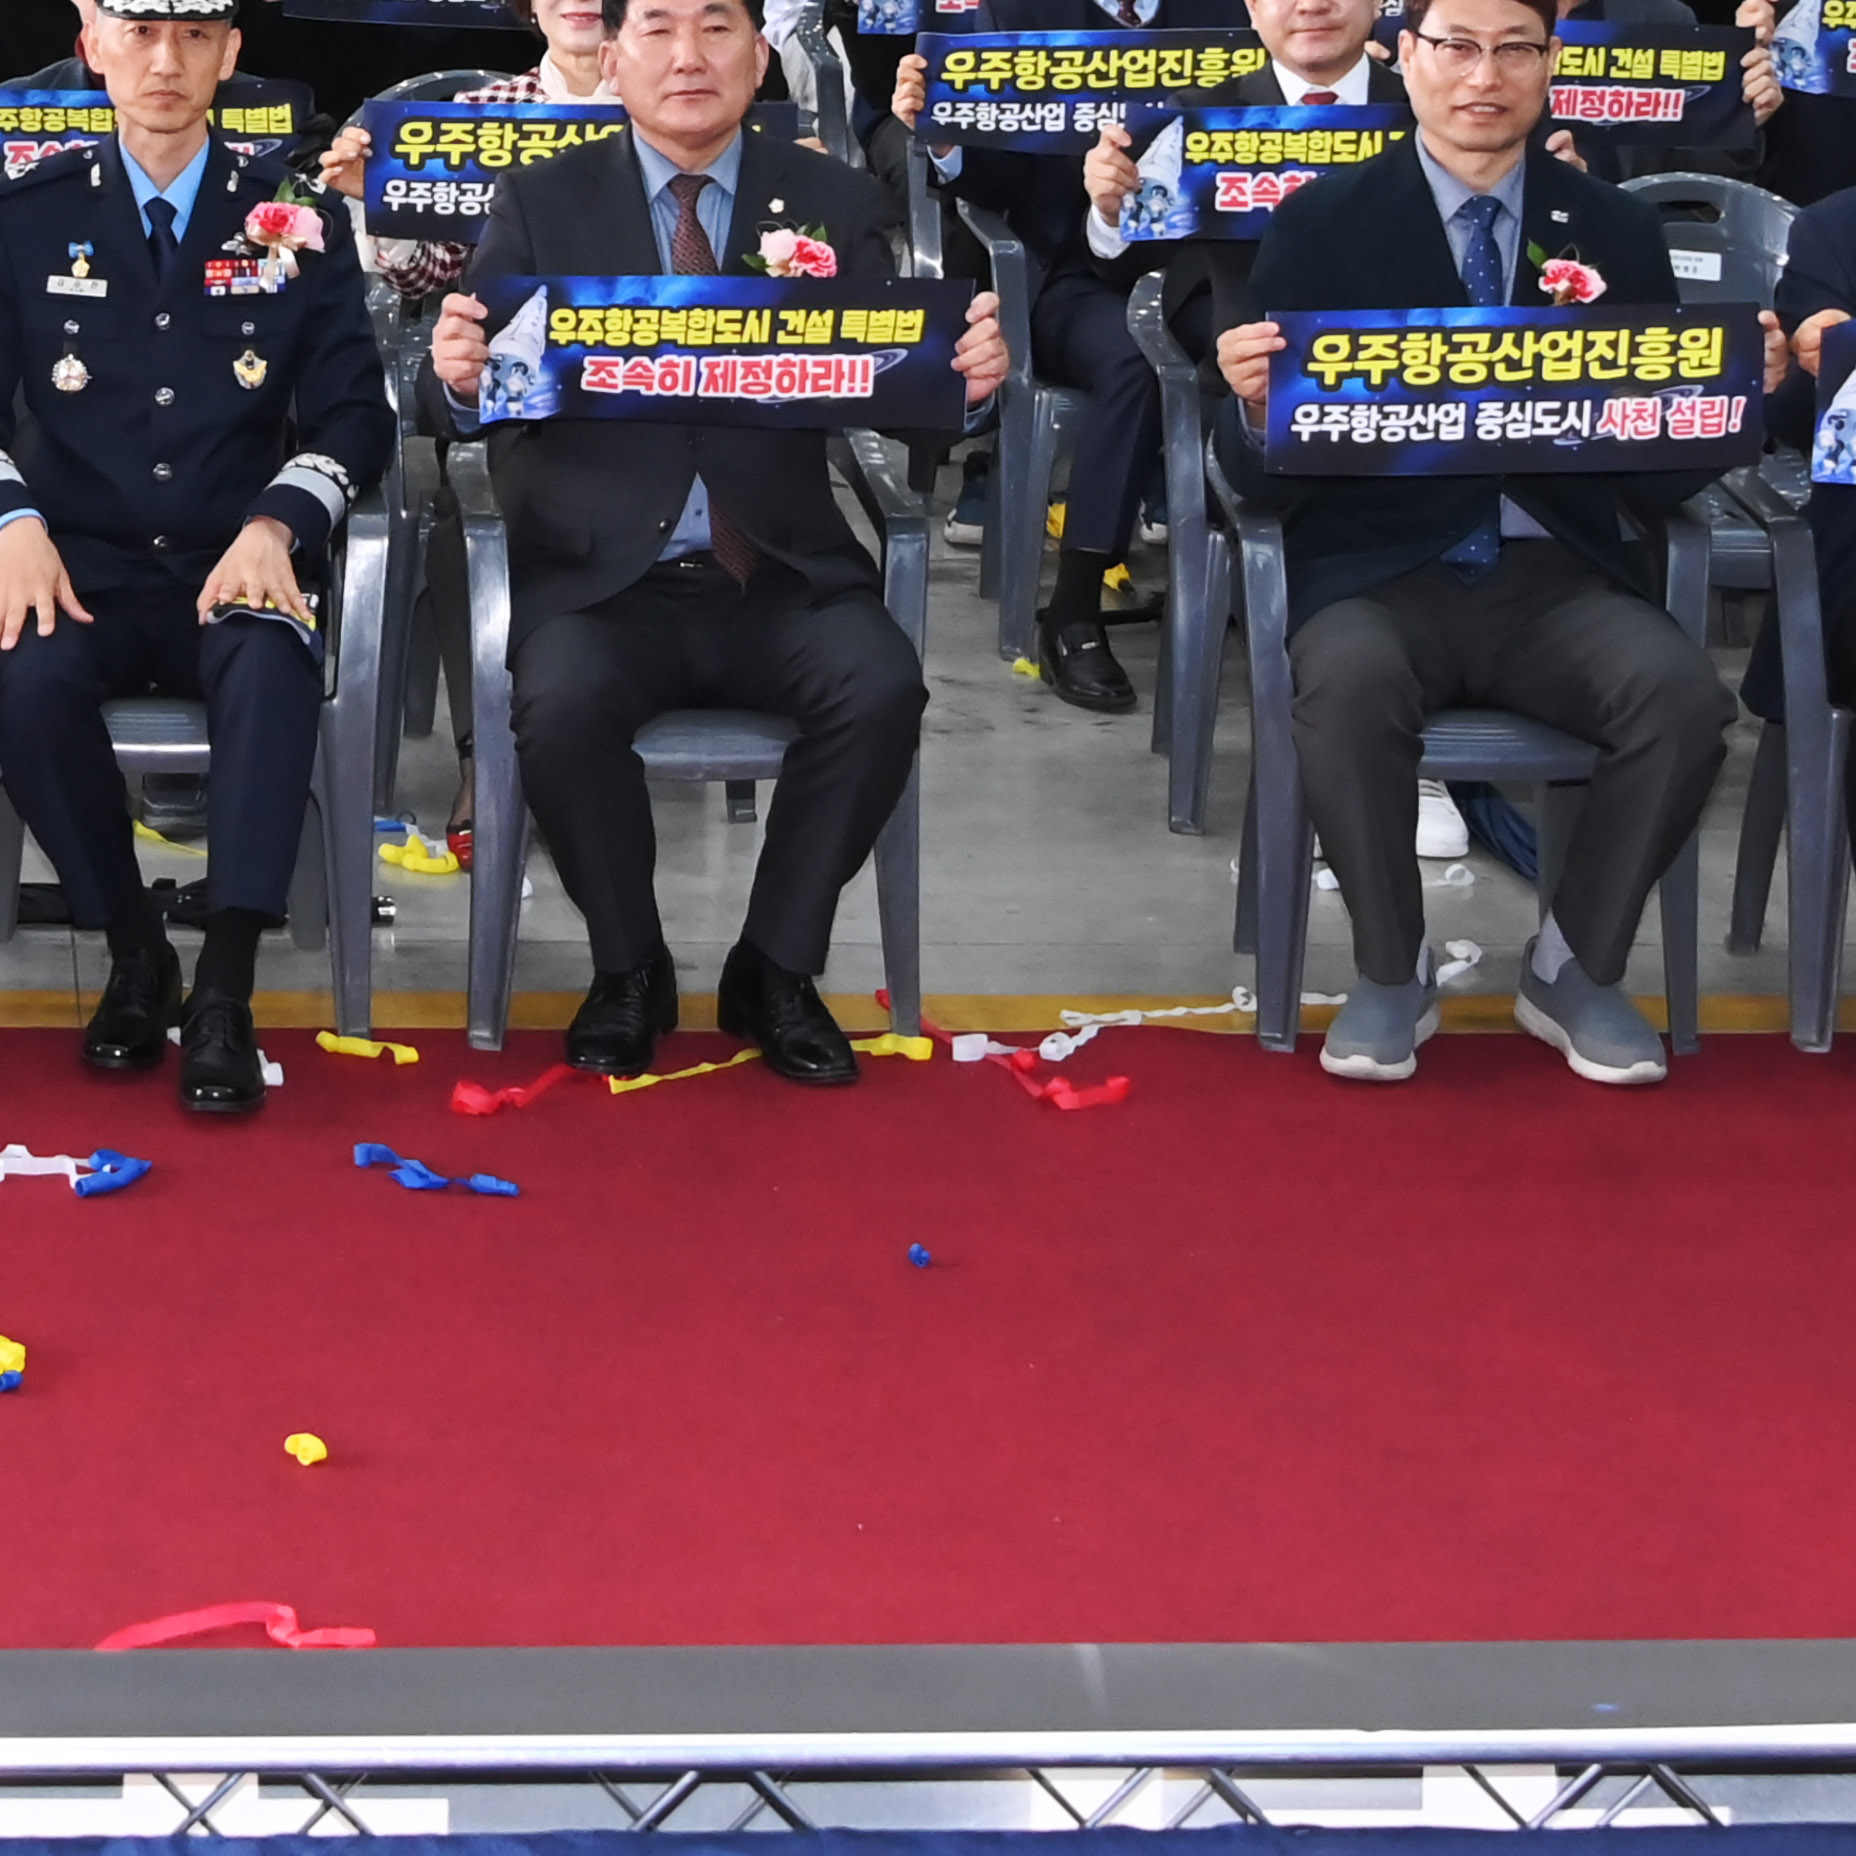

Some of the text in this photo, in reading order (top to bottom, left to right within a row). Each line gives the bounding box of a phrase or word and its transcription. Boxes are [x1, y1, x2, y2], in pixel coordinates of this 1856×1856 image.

[1610, 47, 1725, 82] 건설 특별법
[221, 104, 293, 134] 특별법
[931, 102, 1065, 132] 우주항공산업
[1550, 85, 1686, 121] 제정하라!!
[1185, 131, 1382, 164] 우주항공복합도시
[549, 308, 924, 346] 우주항공복합도시 건설 특별법
[1307, 327, 1724, 385] 우주항공산업진흥원
[580, 355, 875, 398] 조속히 제정하라!!
[1291, 395, 1746, 443] 우주항공산업 중심도시 사천 설립!
